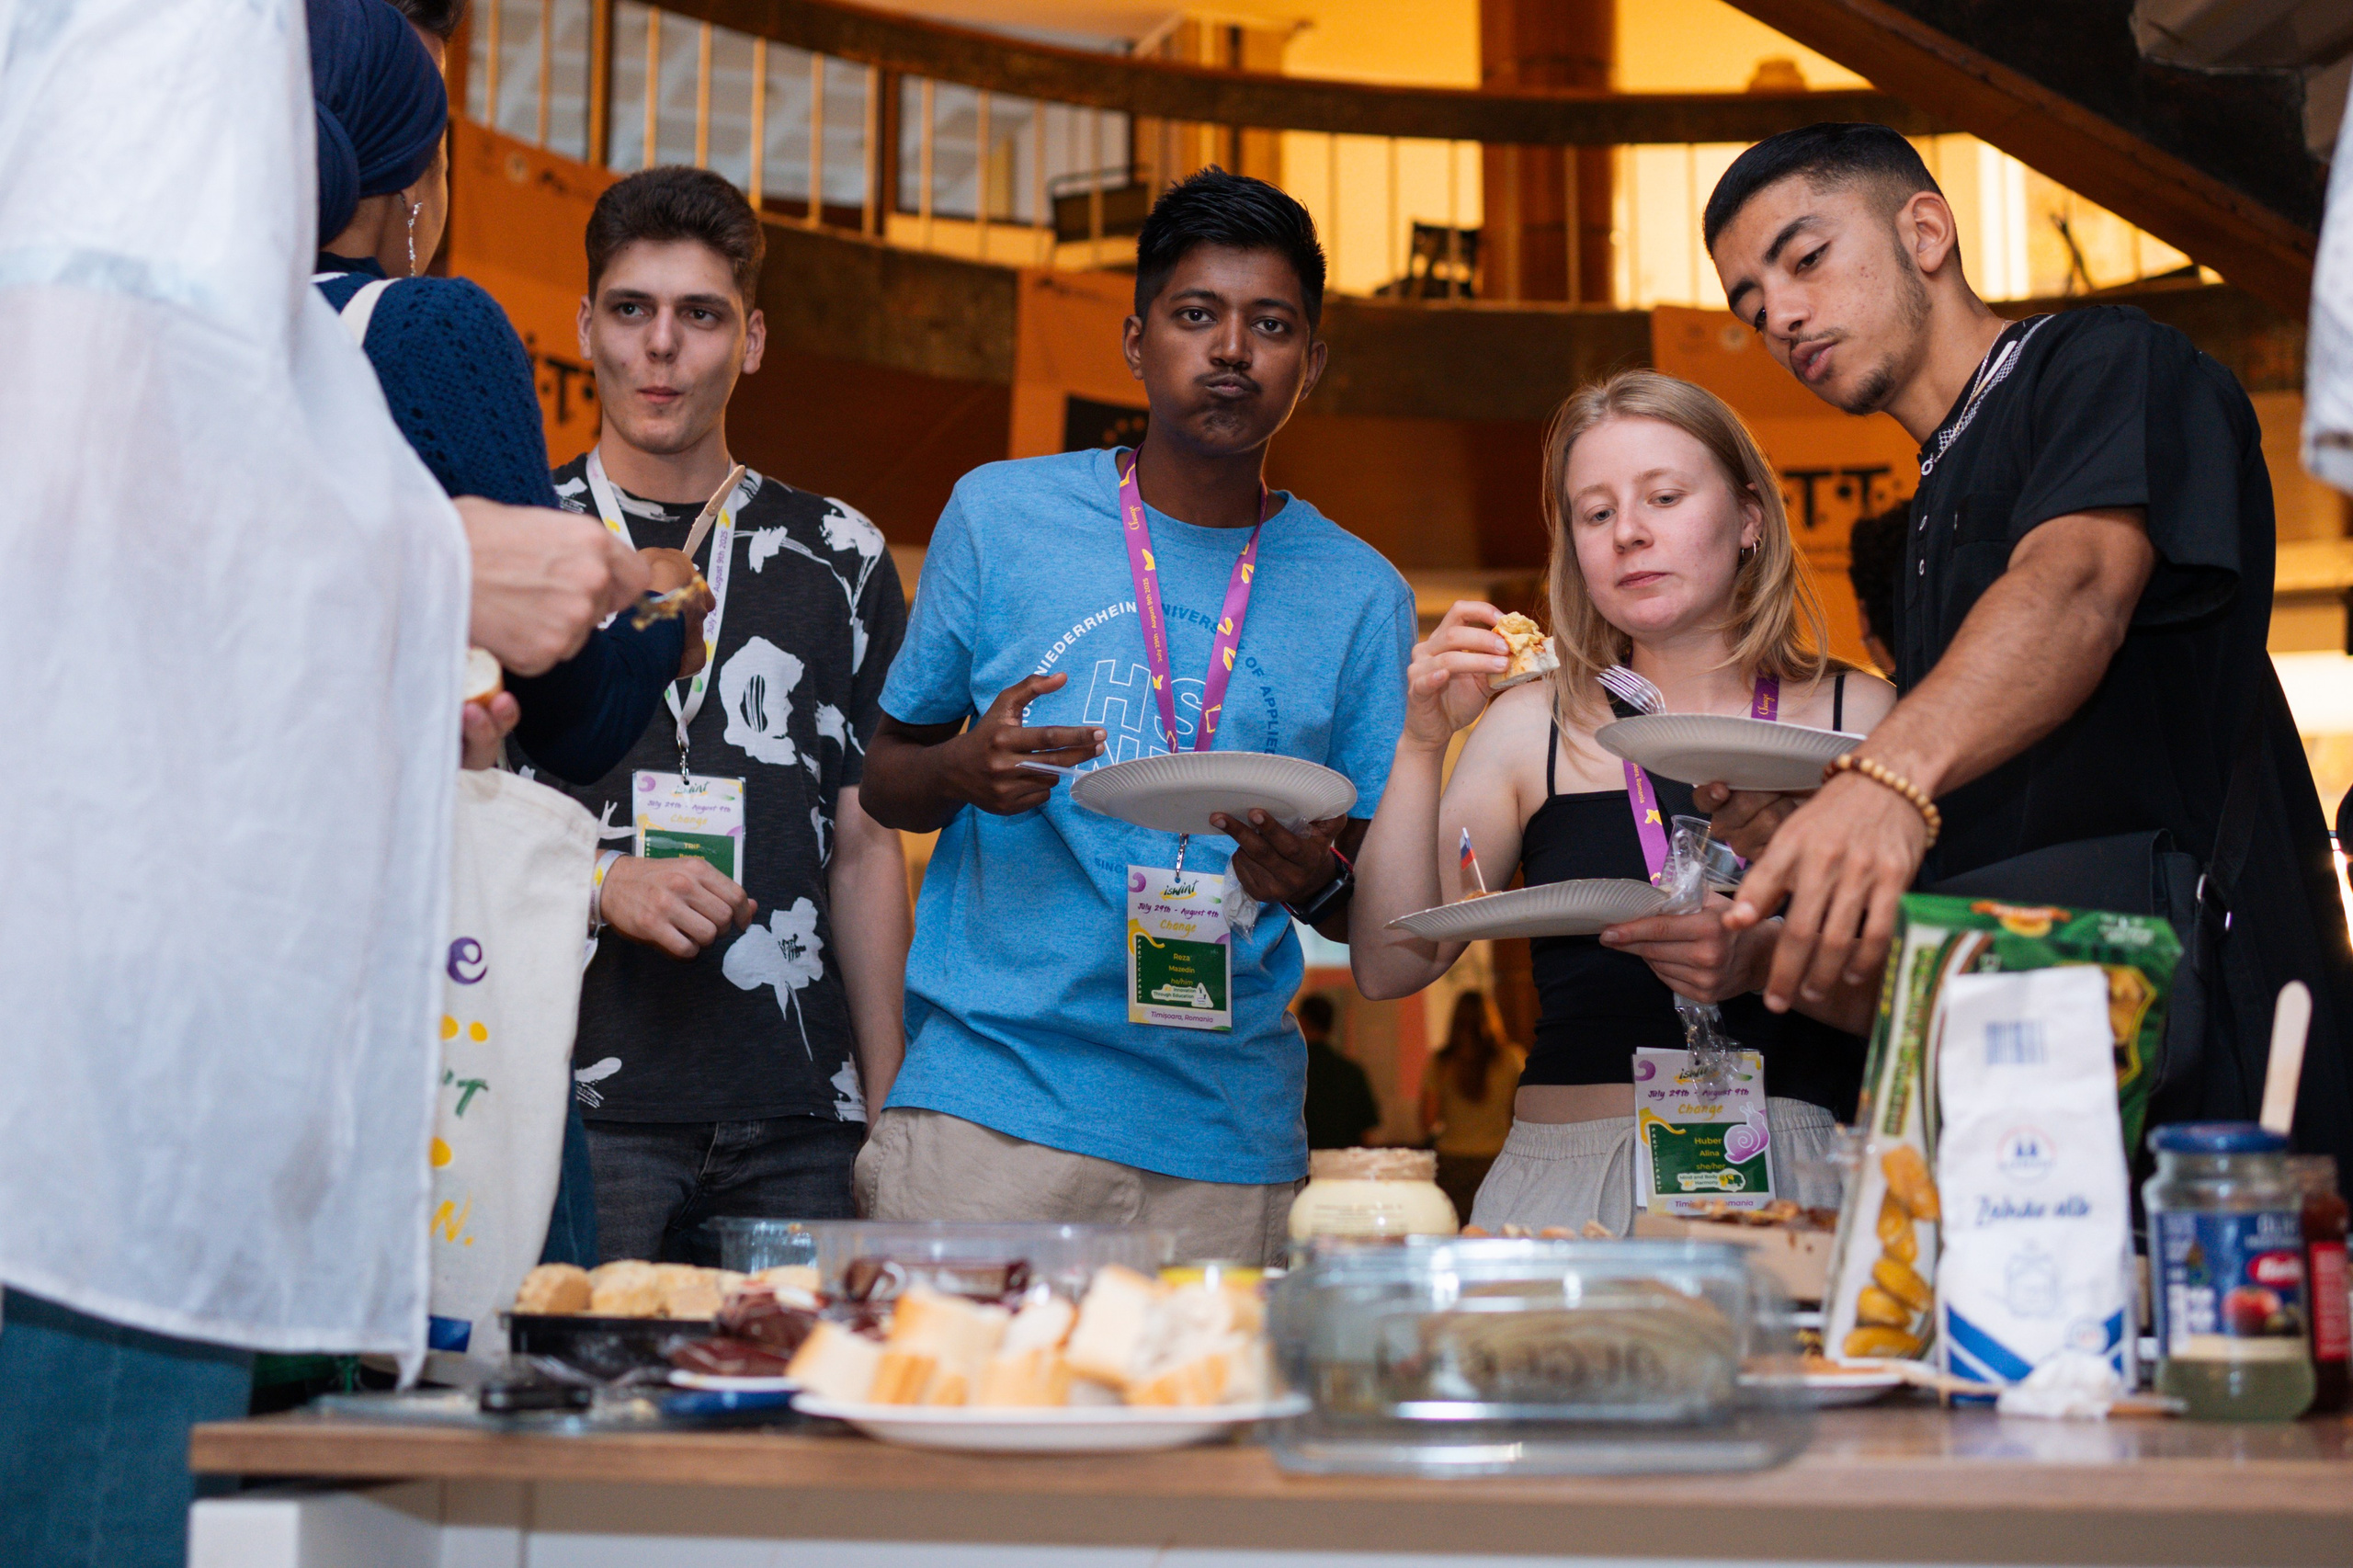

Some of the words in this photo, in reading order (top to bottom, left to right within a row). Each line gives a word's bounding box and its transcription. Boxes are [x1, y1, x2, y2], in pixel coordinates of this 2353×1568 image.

[1129, 505, 1142, 530] Change
[719, 529, 729, 549] 2025
[716, 551, 725, 564] 9th
[713, 565, 724, 592] August
[1142, 577, 1151, 594] 2025
[1145, 594, 1154, 606] 9th
[1148, 606, 1157, 629] August
[1034, 601, 1137, 676] NIEDERRHEIN
[1245, 656, 1266, 677] OF
[1756, 692, 1776, 716] Change
[647, 800, 662, 810] July
[692, 803, 718, 814] August
[670, 813, 708, 830] Change
[1164, 879, 1199, 896] iswint
[1138, 903, 1152, 914] July
[1154, 904, 1171, 913] 29th
[1180, 908, 1204, 920] August
[1207, 910, 1219, 918] 9th
[1159, 919, 1197, 937] Change
[1173, 953, 1191, 961] Reza
[1168, 965, 1195, 973] Mazedin
[1170, 977, 1194, 986] he/him
[1184, 1014, 1213, 1023] Romania
[1647, 1089, 1665, 1101] July
[1669, 1088, 1689, 1096] 29th
[1701, 1088, 1733, 1101] August
[1734, 1087, 1749, 1096] 9th
[1677, 1103, 1724, 1121] Change
[1694, 1137, 1722, 1145] Huber
[1651, 1127, 1663, 1191] PARTICIPANT
[1699, 1149, 1721, 1157] Alina
[1696, 1162, 1726, 1170] she/her
